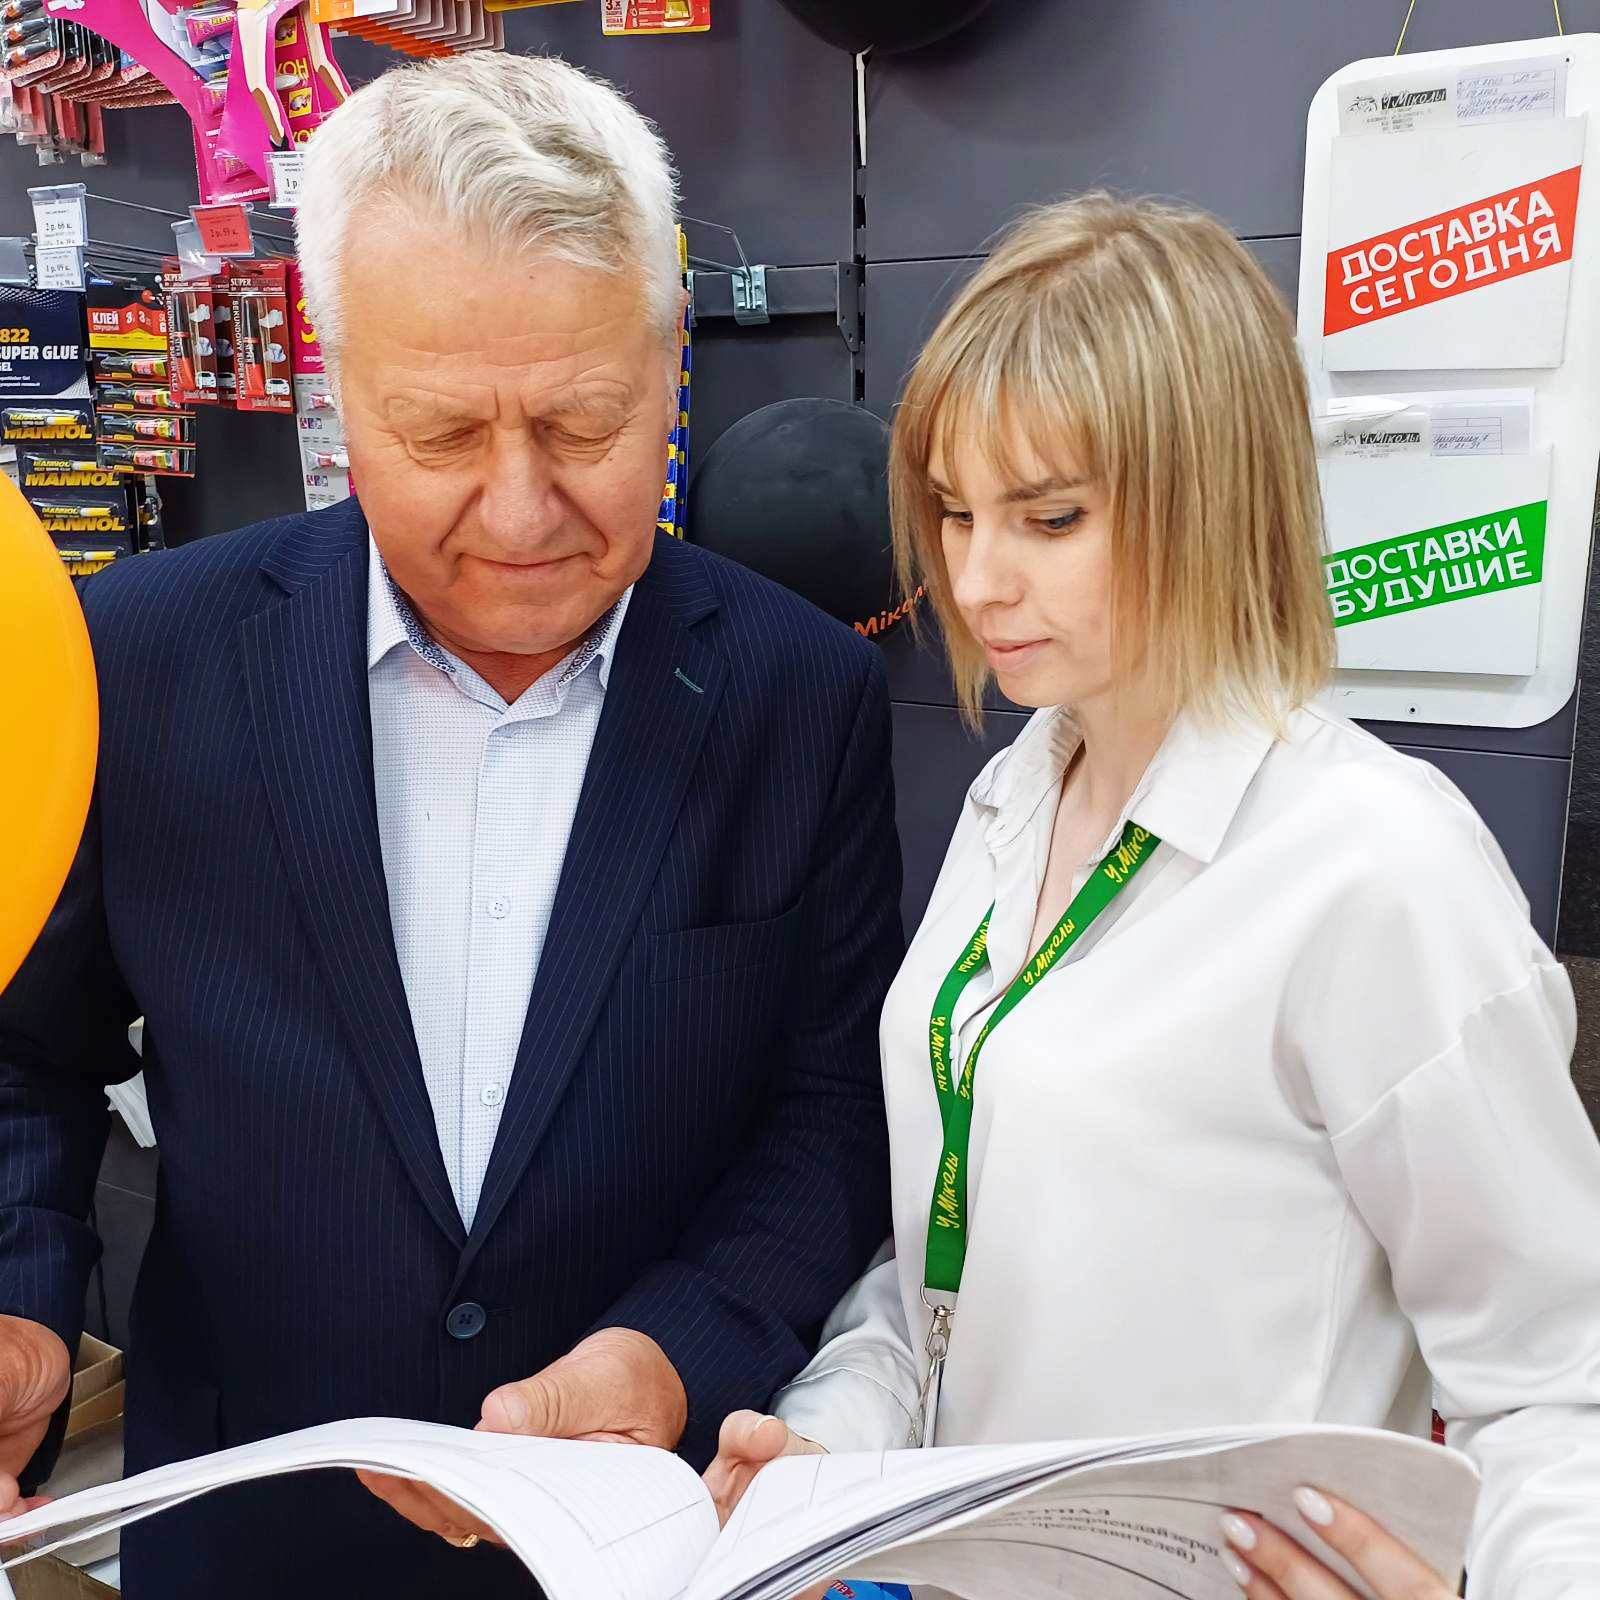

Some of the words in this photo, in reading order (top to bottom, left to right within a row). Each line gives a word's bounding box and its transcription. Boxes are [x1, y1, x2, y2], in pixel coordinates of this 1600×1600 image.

[1341, 190, 1555, 287] ДОСТАВКА
[1349, 222, 1562, 316] СЕГОДНЯ
[92, 310, 119, 325] КЛЕЙ
[42, 345, 79, 360] GLUE
[3, 425, 93, 440] MANNOL
[25, 472, 119, 486] MANNOL
[1326, 516, 1524, 590] ДОСТАВКИ
[1330, 550, 1532, 619] БУДУЩИЕ
